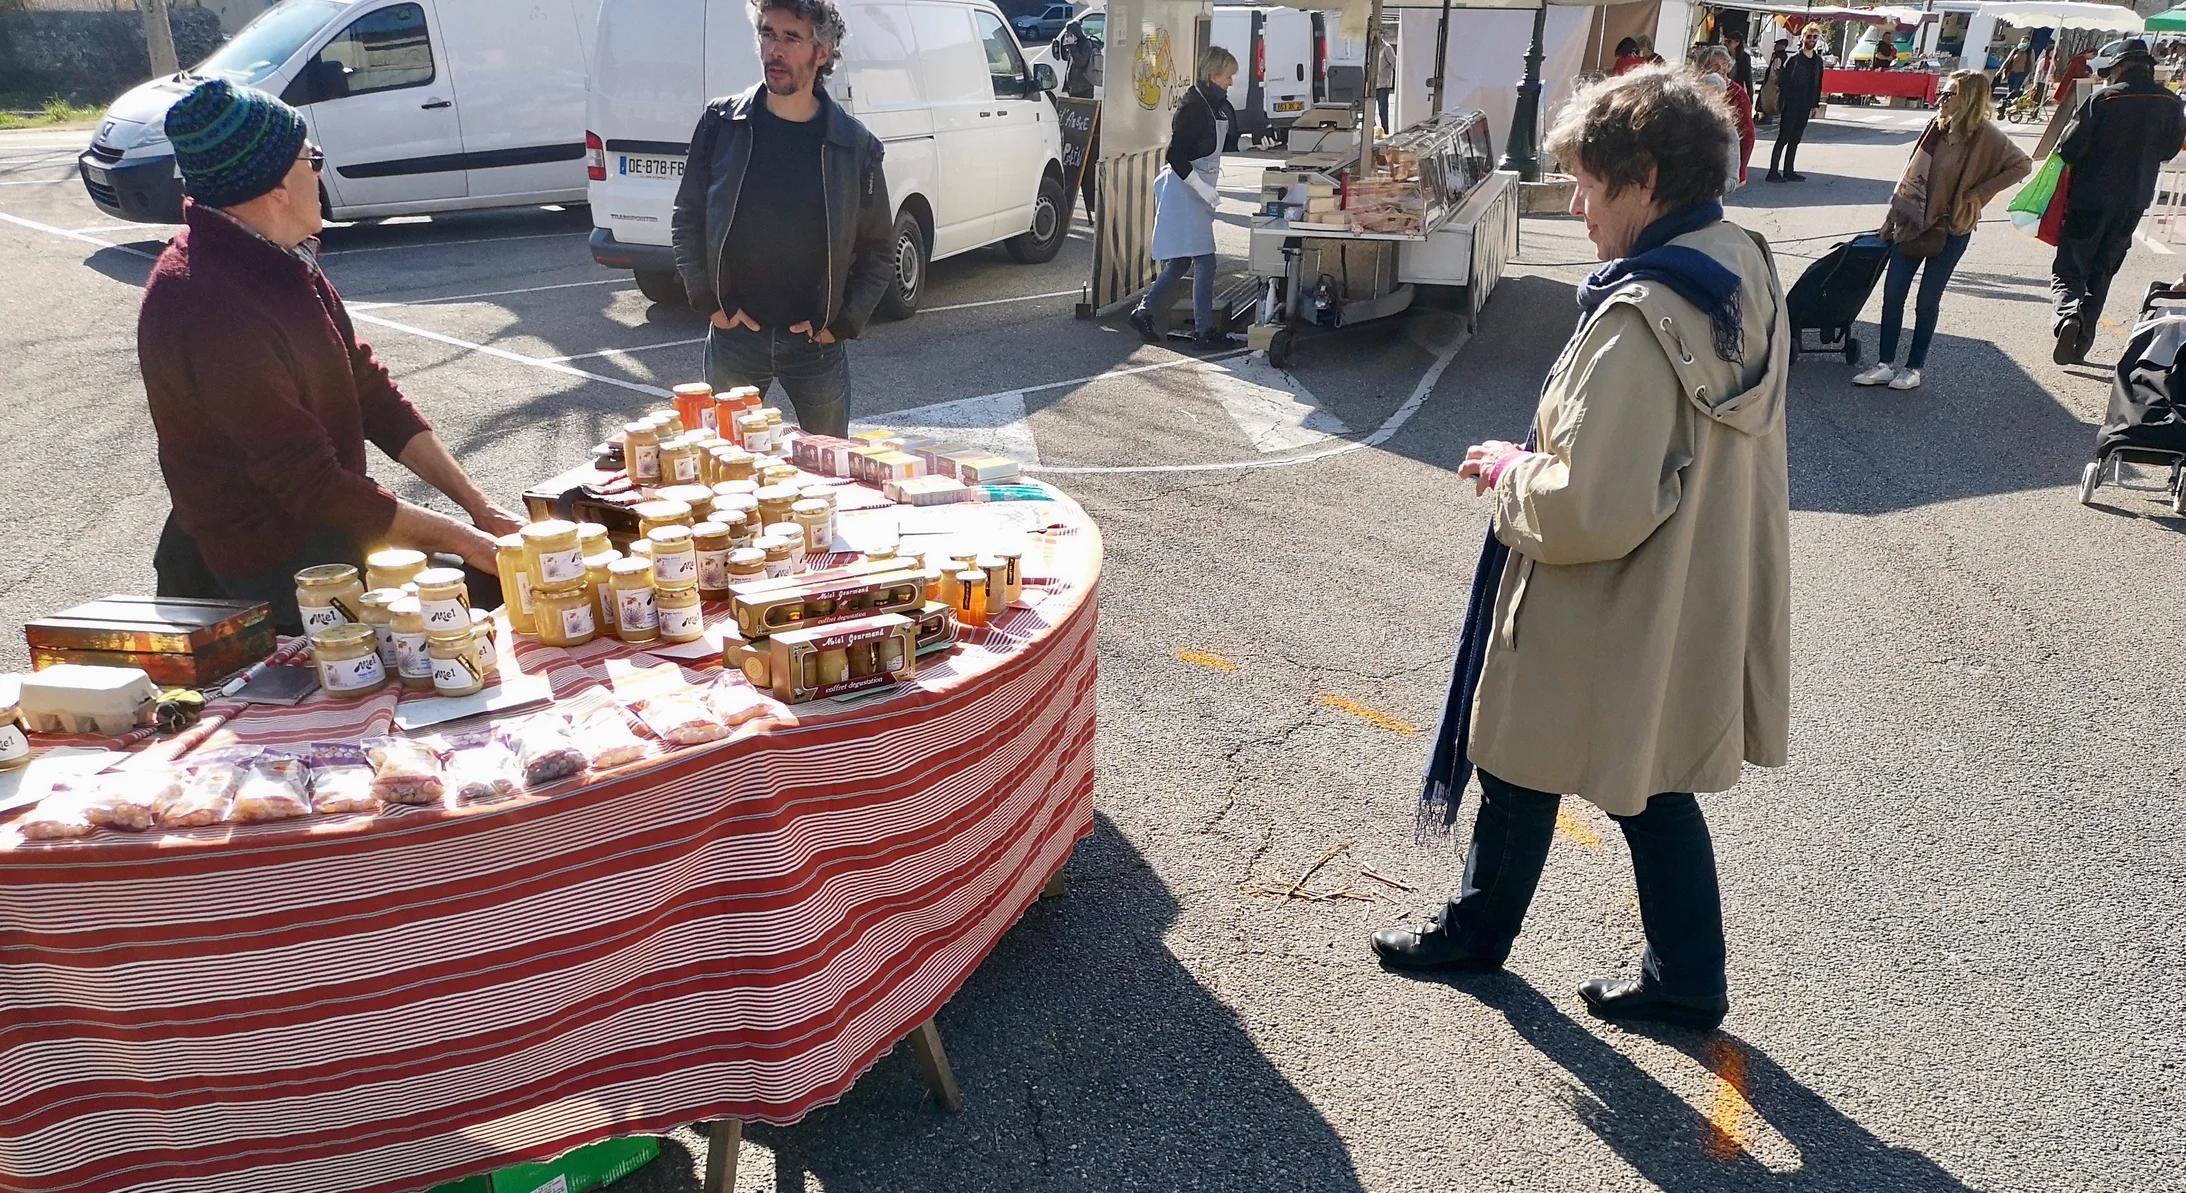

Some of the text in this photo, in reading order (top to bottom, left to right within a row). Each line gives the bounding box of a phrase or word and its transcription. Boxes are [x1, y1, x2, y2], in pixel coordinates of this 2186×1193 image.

[628, 158, 685, 176] DE-878-FB
[816, 585, 869, 601] Miel Gourmand
[309, 610, 337, 625] Miel
[431, 608, 457, 622] Miel
[817, 614, 837, 624] coffret
[822, 627, 885, 649] Miel Gourmand
[354, 655, 377, 673] Miel
[434, 668, 457, 681] Miel
[825, 683, 848, 694] coffret
